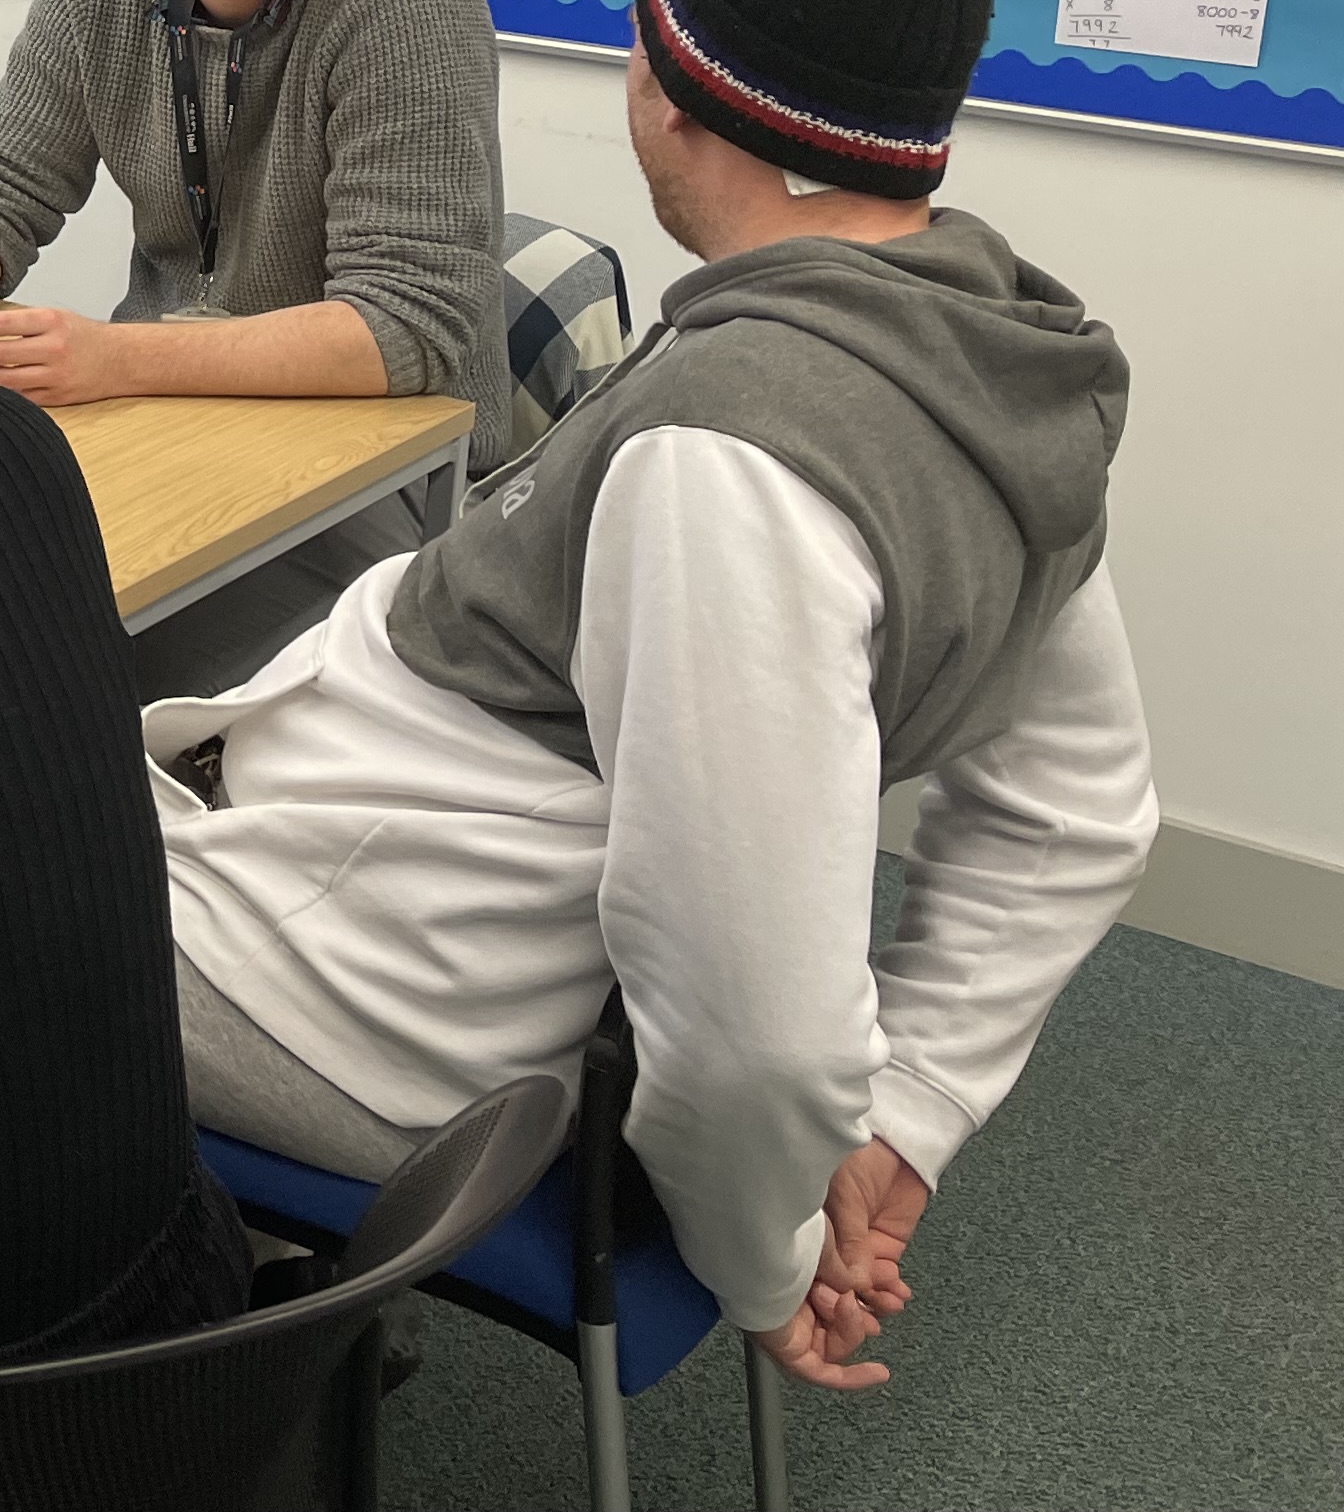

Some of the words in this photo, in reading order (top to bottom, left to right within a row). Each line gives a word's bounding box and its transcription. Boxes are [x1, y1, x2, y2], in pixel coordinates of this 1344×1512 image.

[1104, 0, 1114, 11] 8
[1070, 19, 1119, 33] 7992
[1216, 25, 1254, 39] 7992
